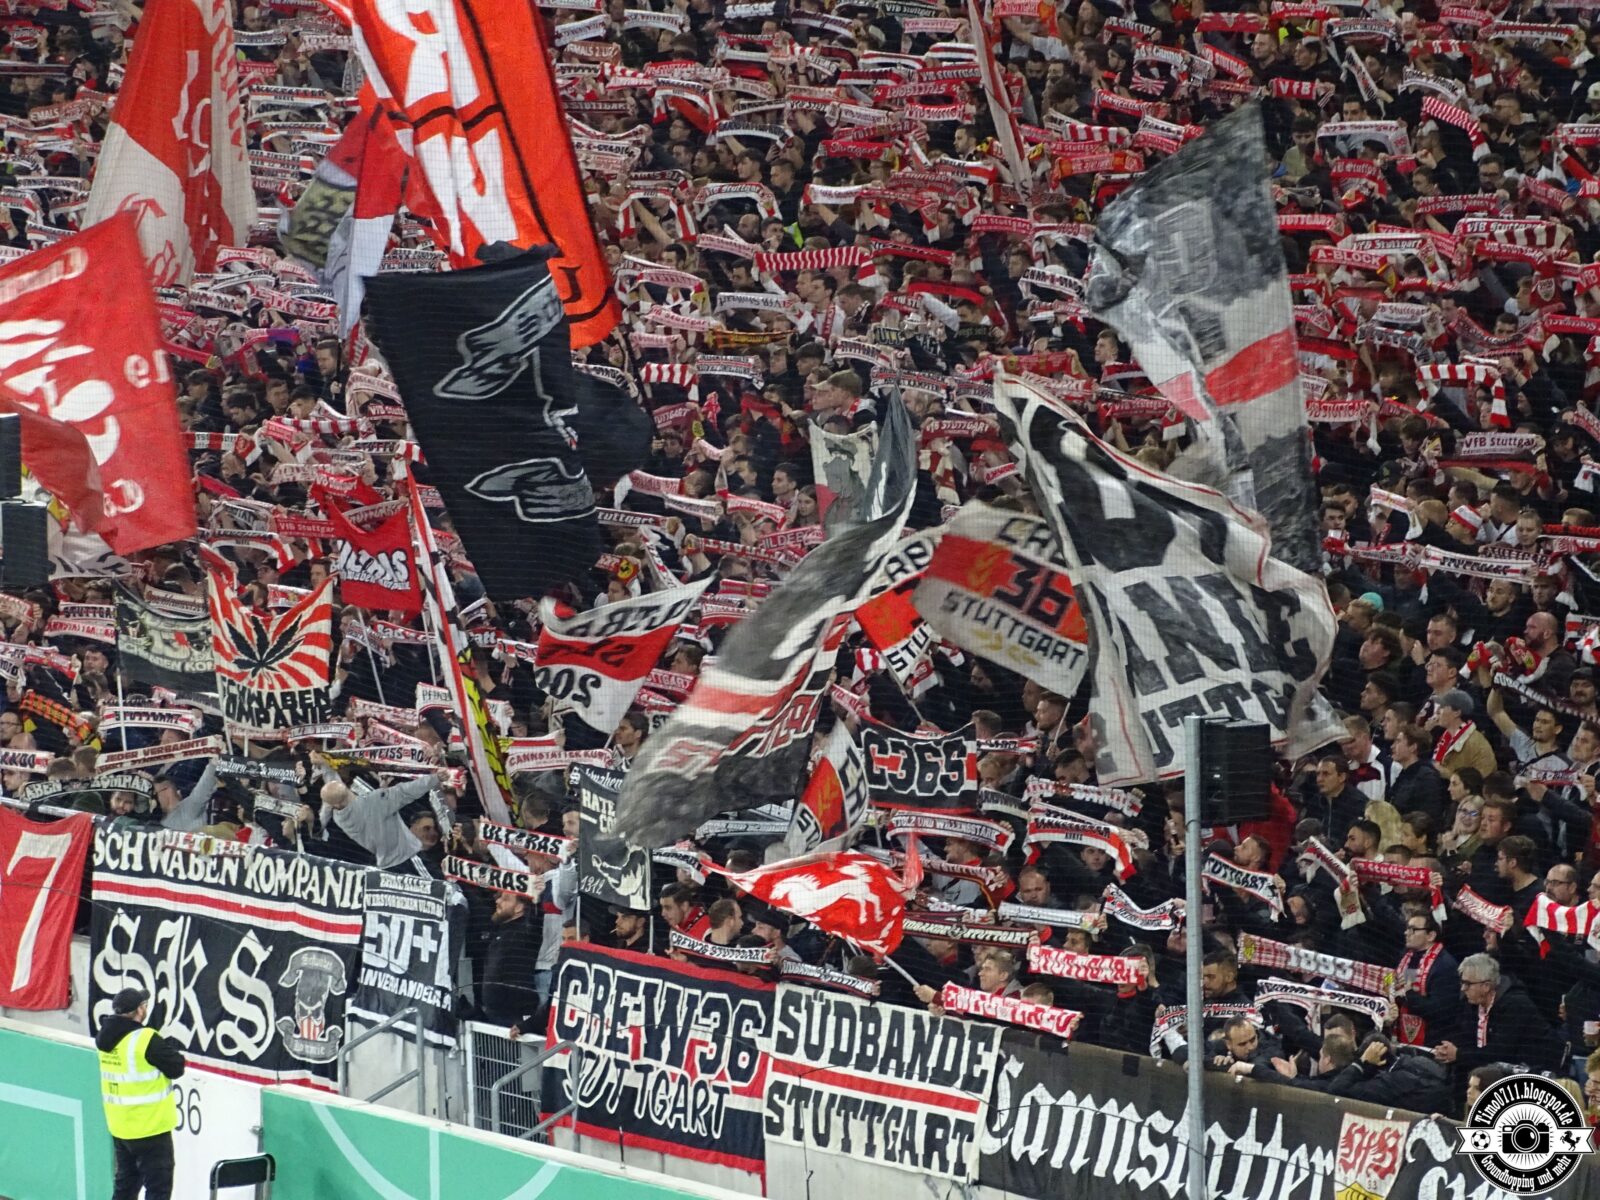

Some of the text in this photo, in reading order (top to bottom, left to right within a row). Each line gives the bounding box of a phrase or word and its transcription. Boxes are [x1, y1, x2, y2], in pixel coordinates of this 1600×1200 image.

[1280, 81, 1312, 95] VfB
[1317, 249, 1381, 266] A-BLOCK
[1464, 437, 1487, 448] VfB
[941, 589, 1087, 671] STUTTGART
[105, 751, 139, 763] JEDER
[482, 823, 563, 856] ULTRAS
[92, 827, 365, 910] SCHWABEN KOMPANIE
[446, 855, 529, 892] ULTRAS
[7, 831, 73, 992] 7
[362, 912, 453, 992] 50+1
[963, 928, 1030, 946] STUTTGART
[1029, 945, 1140, 984] STUTTGART
[1286, 945, 1353, 981] 1893
[773, 987, 999, 1094] SÜDBANDE
[765, 1074, 974, 1177] STUTTGART
